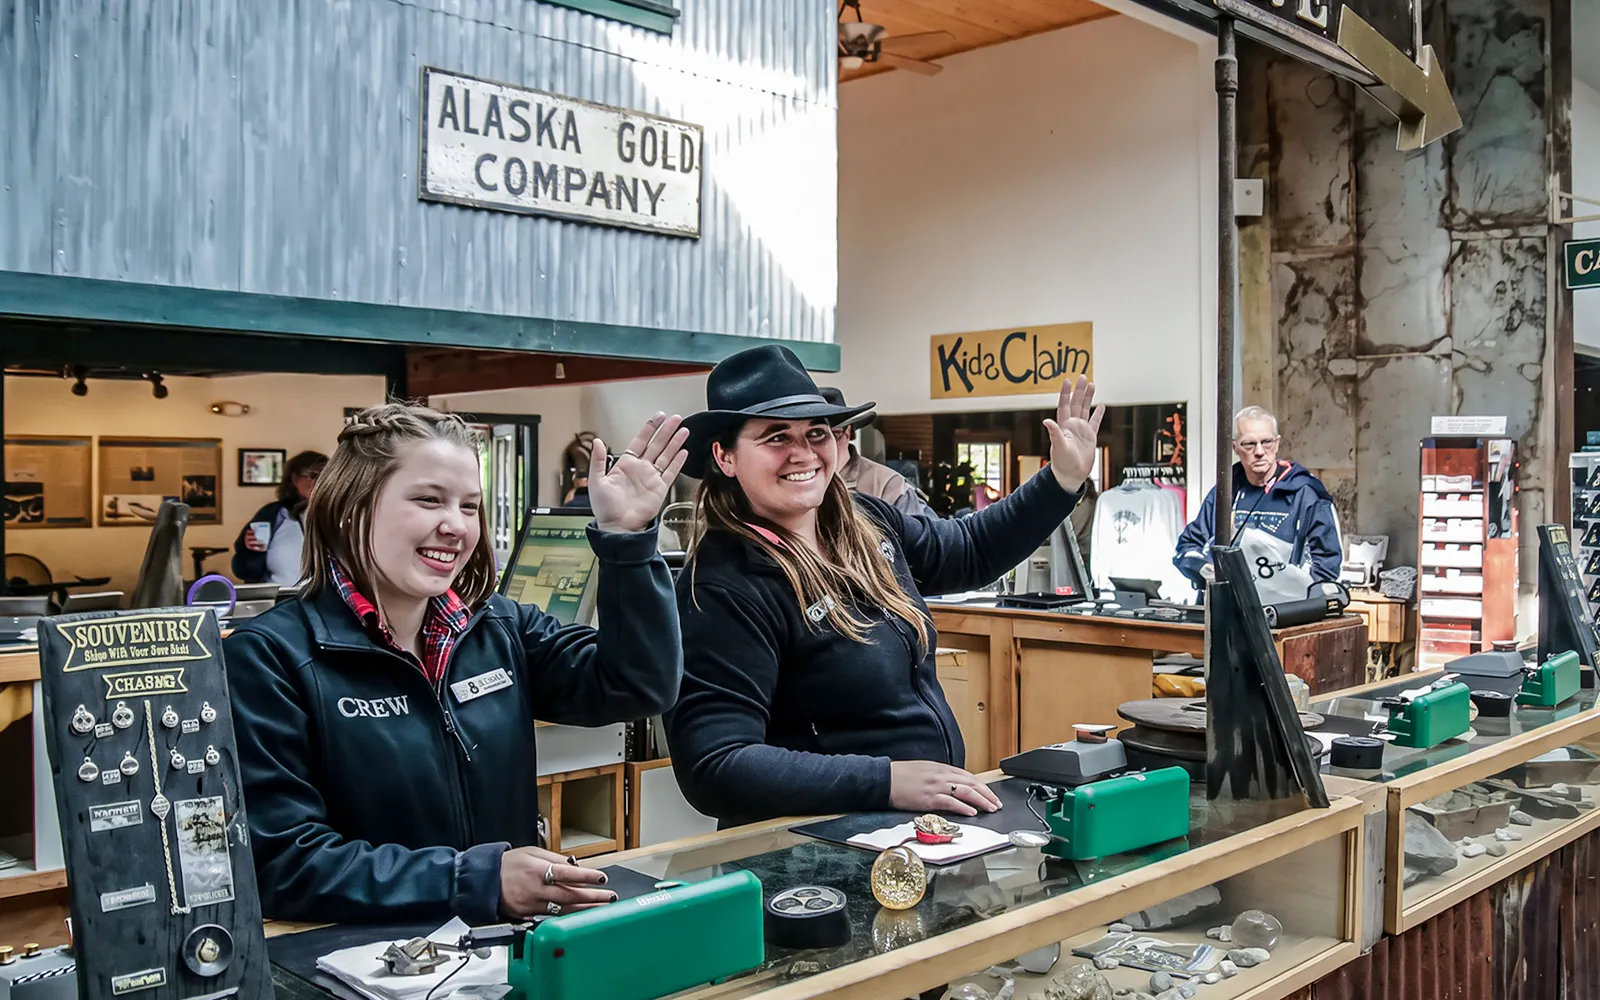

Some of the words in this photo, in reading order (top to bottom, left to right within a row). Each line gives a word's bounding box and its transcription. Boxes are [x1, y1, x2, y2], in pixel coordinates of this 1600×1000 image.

[438, 85, 581, 154] ALASKA
[617, 122, 694, 174] GOLD
[474, 153, 666, 216] COMPANY
[937, 336, 1000, 393] Kids
[1000, 331, 1090, 384] Claim
[75, 619, 191, 648] SOUVENIRS
[337, 695, 409, 718] CREW
